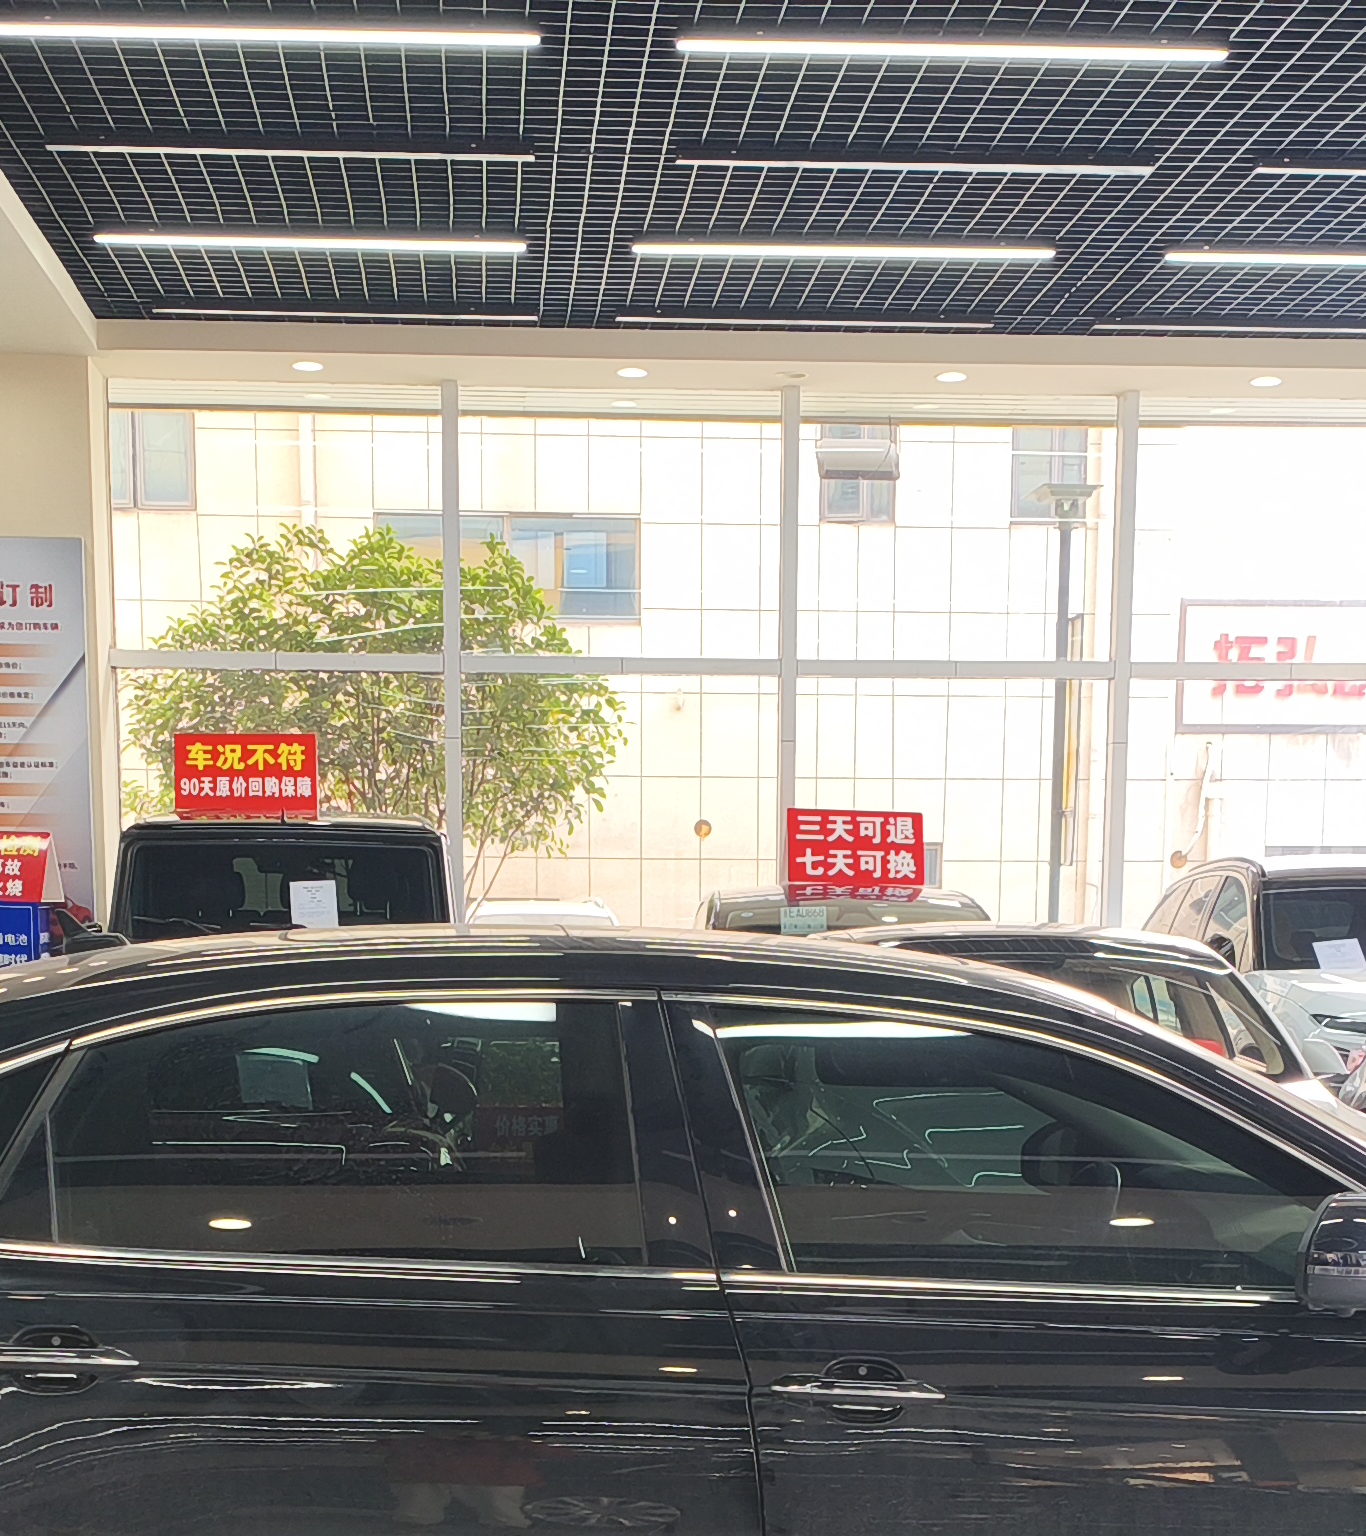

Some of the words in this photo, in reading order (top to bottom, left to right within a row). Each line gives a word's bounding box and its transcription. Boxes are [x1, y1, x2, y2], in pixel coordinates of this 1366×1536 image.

[185, 742, 306, 771] 车况不符
[180, 776, 312, 798] 90天原价回购保障
[795, 815, 916, 844] 三天可退
[795, 848, 917, 879] 七天可换
